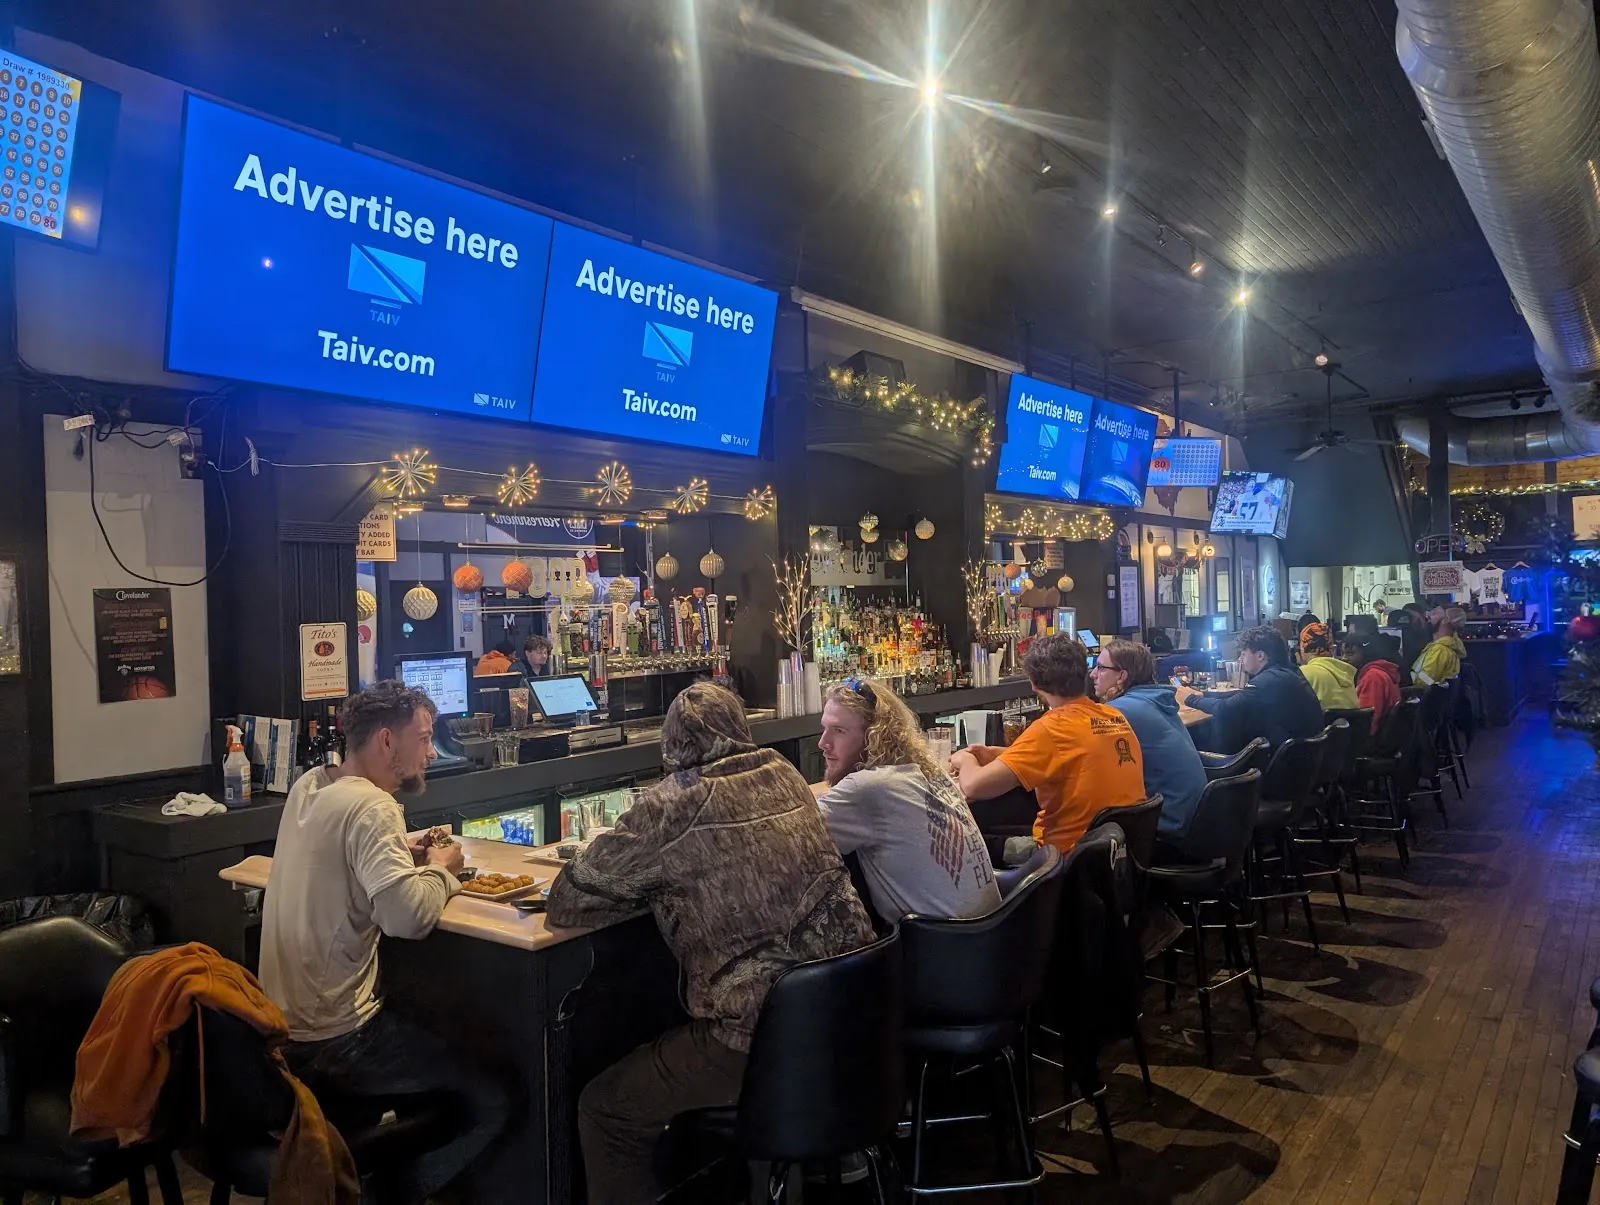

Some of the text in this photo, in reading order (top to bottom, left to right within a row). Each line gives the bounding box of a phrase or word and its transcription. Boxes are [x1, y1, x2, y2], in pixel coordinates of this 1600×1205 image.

[3, 57, 70, 90] Draw # 1989330
[0, 90, 69, 122] 16 17 18 19 20
[63, 96, 71, 104] 10
[11, 132, 19, 141] 37
[58, 131, 67, 139] 30
[8, 151, 17, 160] 47
[6, 168, 14, 177] 57
[3, 186, 12, 195] 67
[49, 201, 58, 209] 70
[1, 204, 56, 228] 77 78 79 80
[233, 153, 518, 268] Advertise here
[575, 258, 754, 335] Advertise here
[369, 309, 401, 326] TAIV
[318, 329, 435, 376] Taiv.com
[655, 371, 676, 384] TAIV
[491, 396, 517, 410] TAIV
[622, 388, 697, 422] Taiv.com
[1018, 392, 1083, 425] Advertise here
[1095, 412, 1150, 441] Advertise here
[732, 434, 750, 446] TAIV
[1028, 464, 1057, 481] Taiv.com
[1154, 460, 1166, 469] 80
[1240, 501, 1259, 521] 57
[310, 628, 338, 640] Tito's
[307, 657, 342, 667] Handmade
